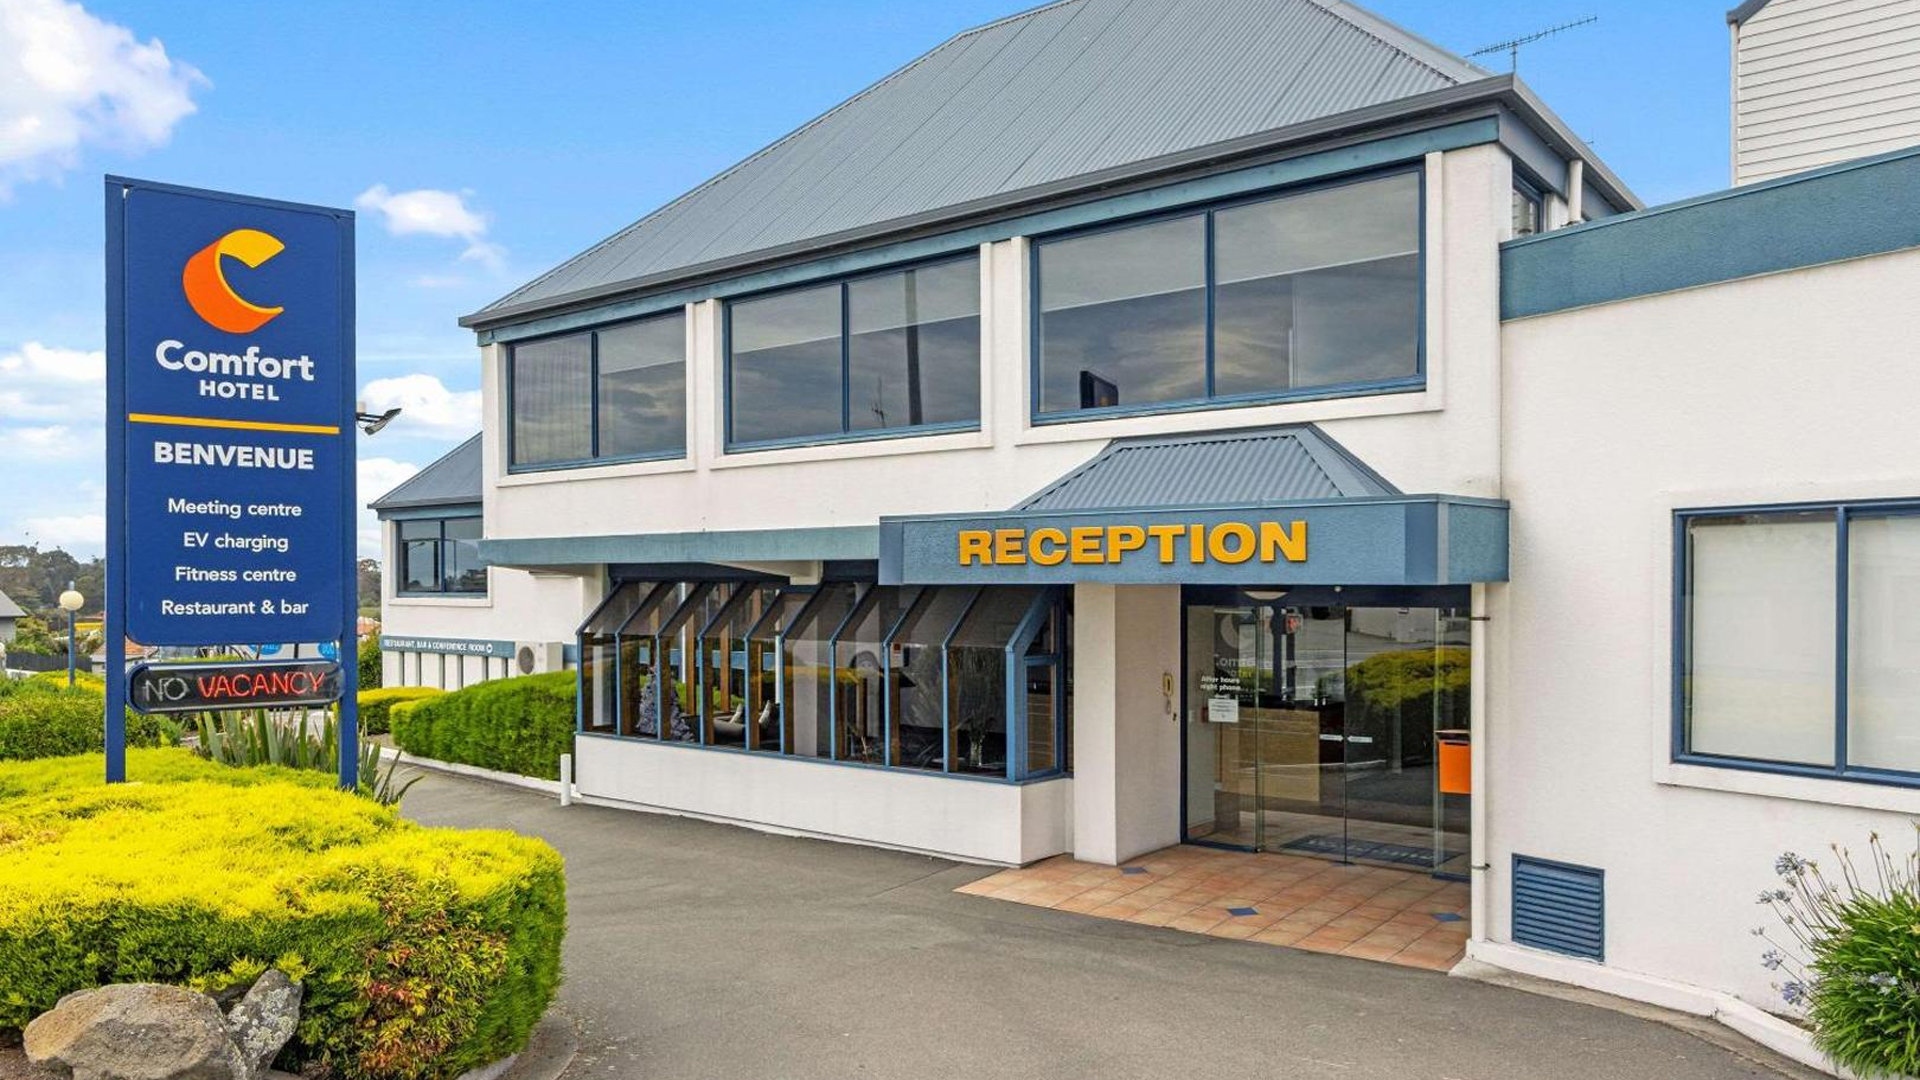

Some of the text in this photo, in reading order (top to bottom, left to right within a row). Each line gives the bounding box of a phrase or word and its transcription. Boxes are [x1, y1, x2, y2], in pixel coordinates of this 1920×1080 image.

[156, 340, 314, 382] Comfort
[200, 380, 279, 401] HOTEL
[154, 441, 314, 470] BENVENUE
[168, 498, 302, 519] Meeting centre
[183, 532, 289, 552] EV charging
[959, 521, 1306, 565] RECEPTION
[175, 566, 297, 582] Fitness centre
[162, 599, 309, 615] Restaurant & bar
[143, 673, 324, 701] NO VACANCY
